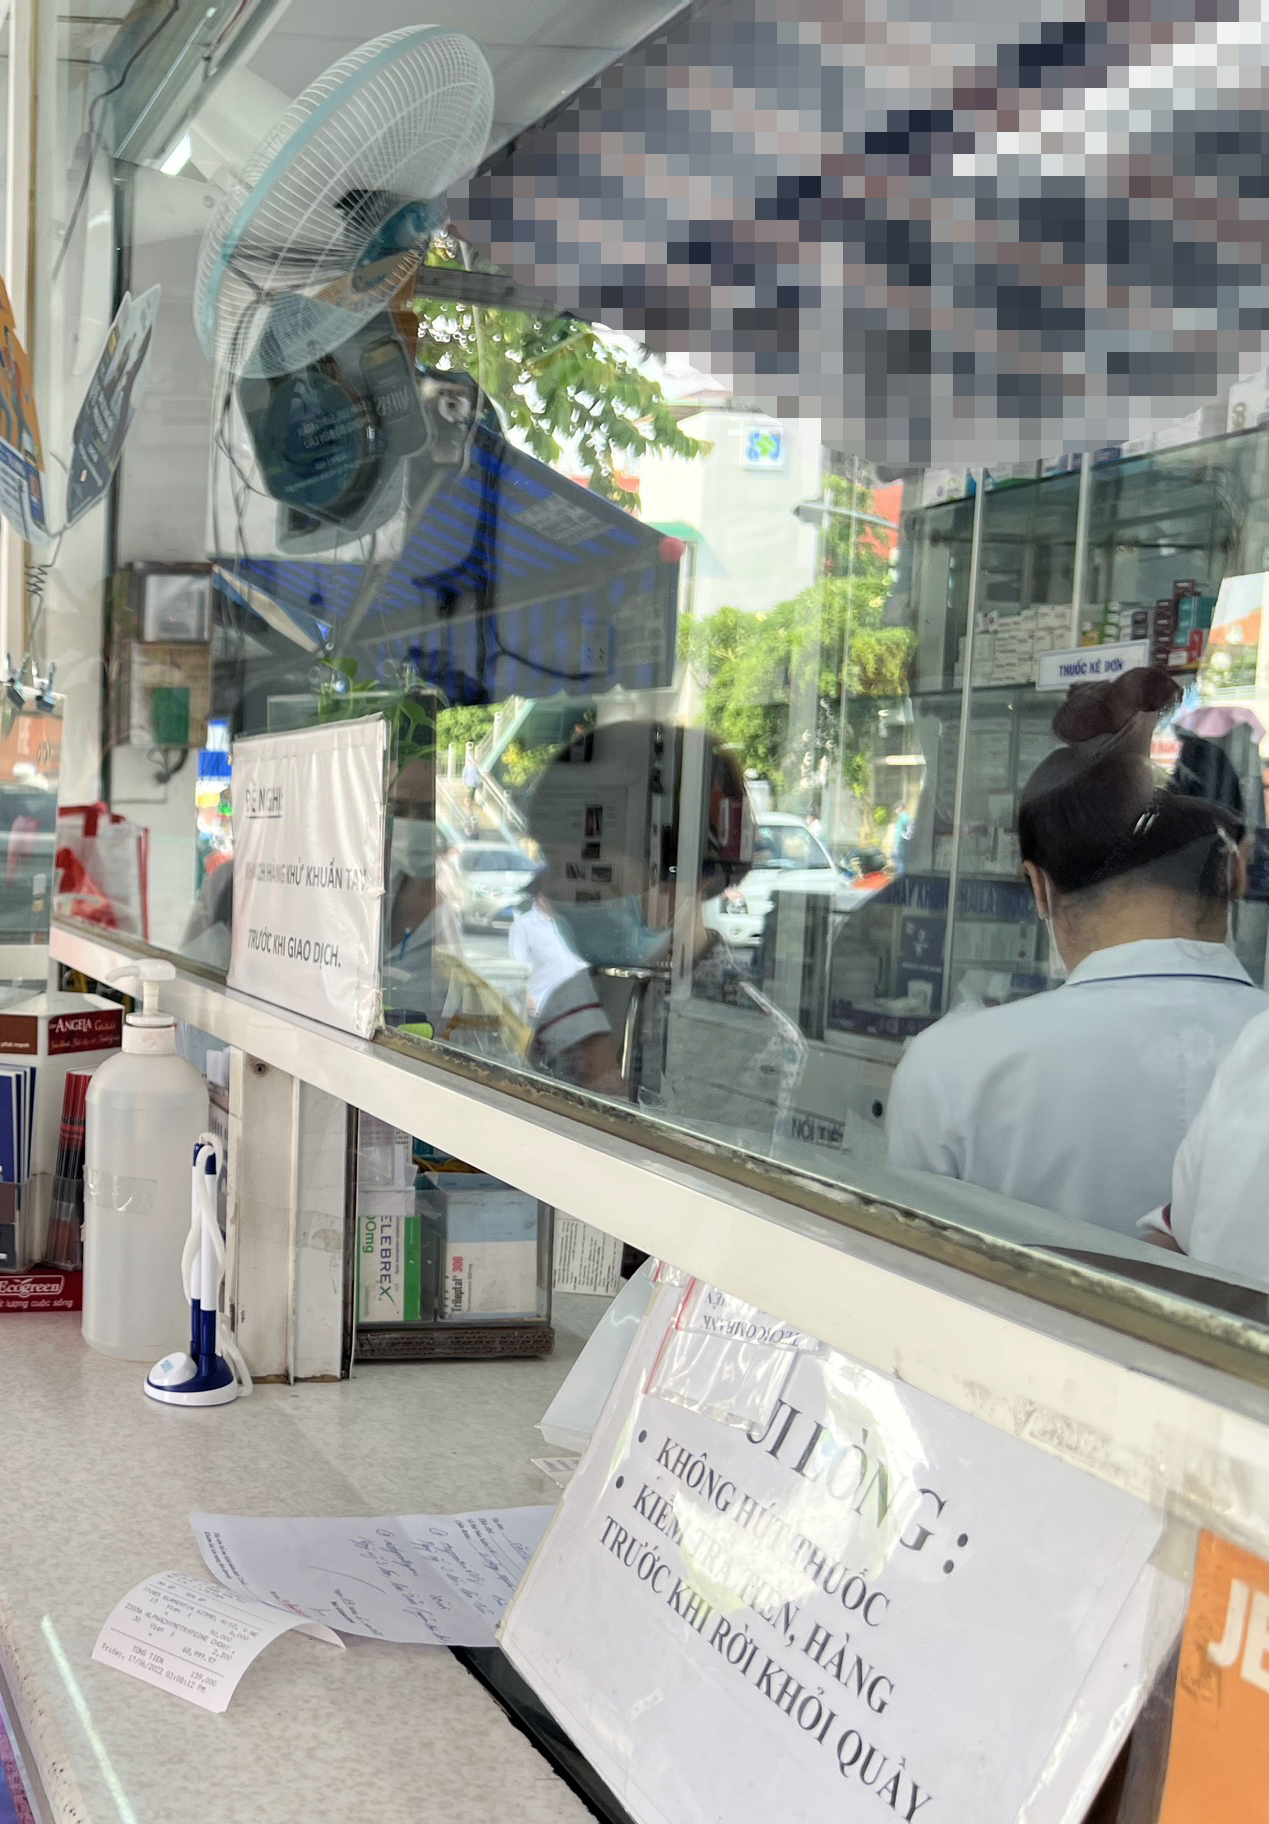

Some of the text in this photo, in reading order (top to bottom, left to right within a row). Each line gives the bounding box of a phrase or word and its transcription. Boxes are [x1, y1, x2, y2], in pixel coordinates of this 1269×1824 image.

[247, 926, 341, 970] TRƯỚC KHI GIAO DỊCH.
[55, 1017, 93, 1034] ANGELA
[379, 1216, 393, 1299] ELEBREX
[452, 1255, 464, 1273] 300
[655, 1435, 737, 1513] KHÔNG
[793, 1533, 891, 1628] THUỐC
[127, 1653, 163, 1675] 17/06/2022
[197, 1684, 206, 1693] PM
[149, 1652, 164, 1664] TIEN
[190, 1670, 217, 1688] 159,000
[599, 1515, 672, 1594] TRƯỚC
[666, 1577, 715, 1635] KHI
[708, 1615, 761, 1677] RỜI
[754, 1656, 839, 1744] KHỎI
[836, 1730, 934, 1823] QUẦY
[800, 1621, 895, 1714] HÀNG
